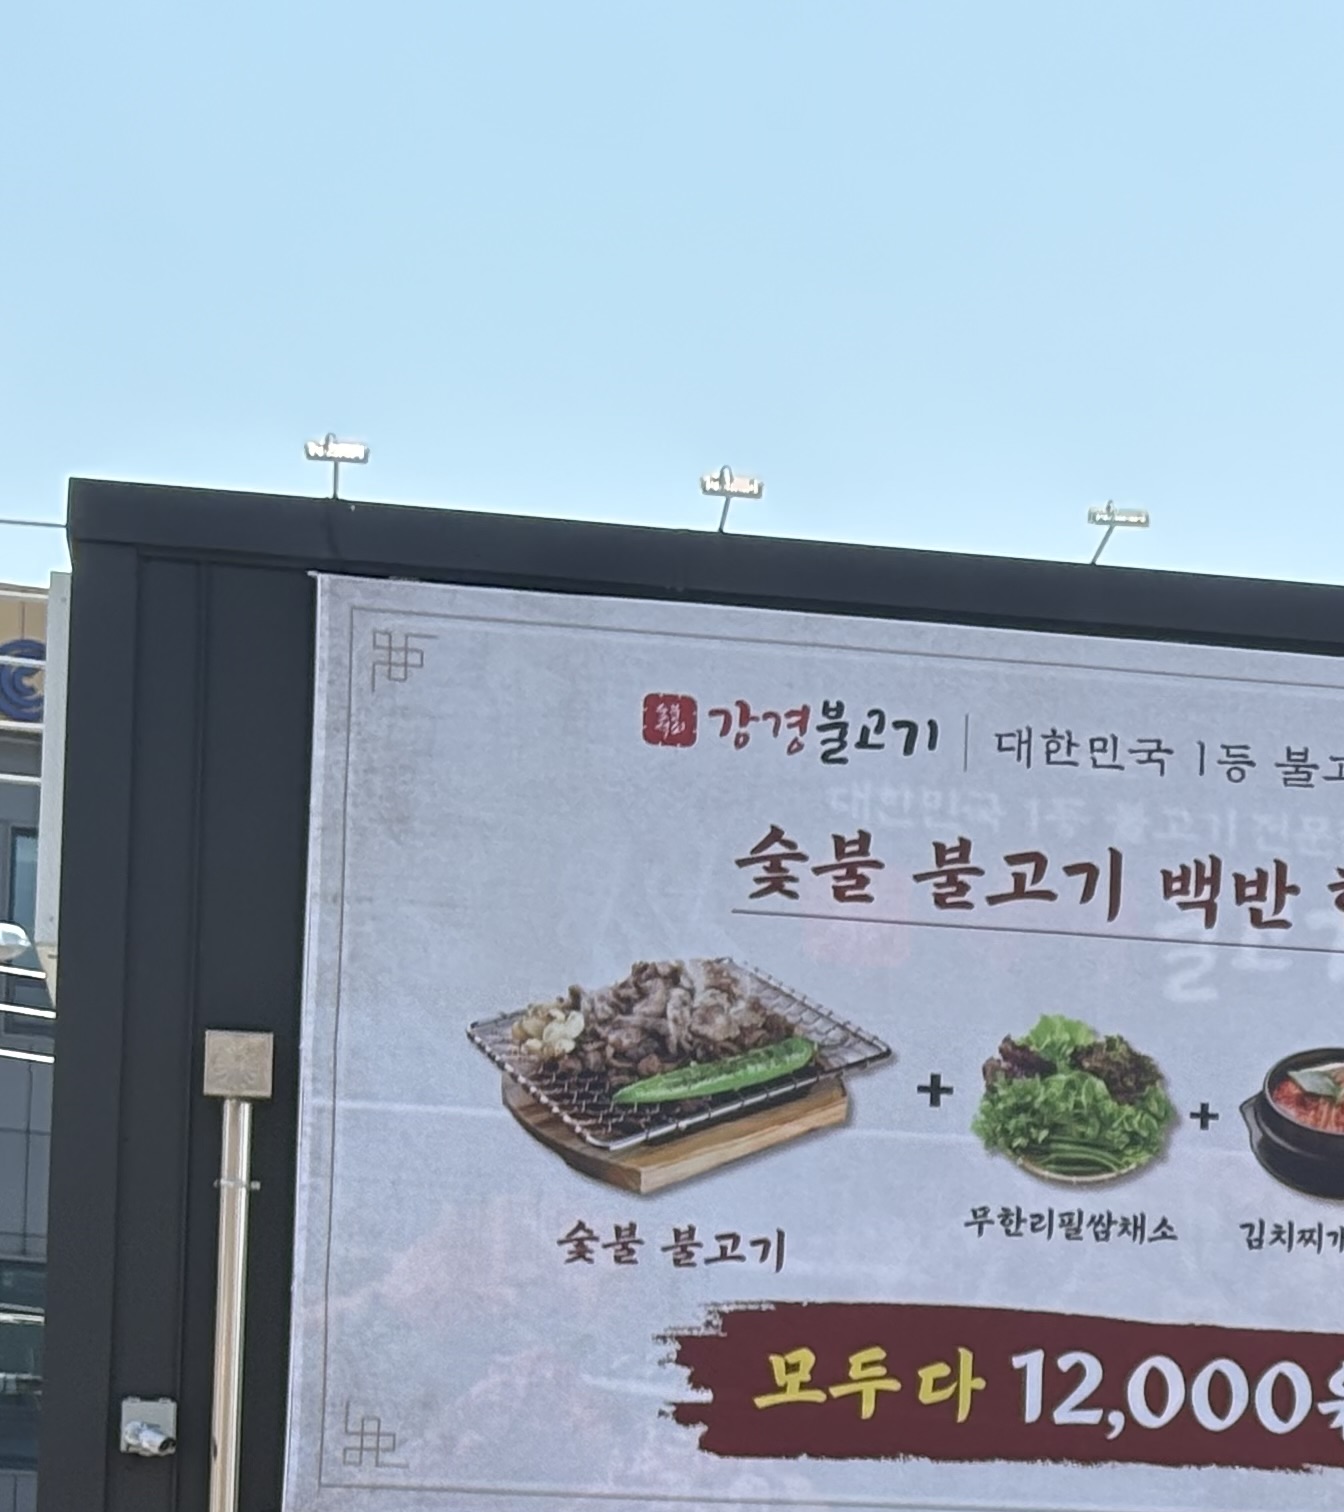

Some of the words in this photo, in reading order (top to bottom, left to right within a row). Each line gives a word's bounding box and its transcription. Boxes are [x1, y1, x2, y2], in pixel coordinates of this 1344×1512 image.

[708, 699, 938, 765] 강경불고기
[994, 725, 1175, 777] 대한민국
[735, 824, 885, 903] 숯불
[913, 837, 1123, 922] 불고기
[1161, 854, 1300, 930] 백반
[557, 1219, 646, 1266] 숯불
[661, 1224, 786, 1273] 불고기
[964, 1205, 1179, 1245] 무한리필쌈채소
[753, 1346, 901, 1421] 모두
[916, 1347, 986, 1424] 다
